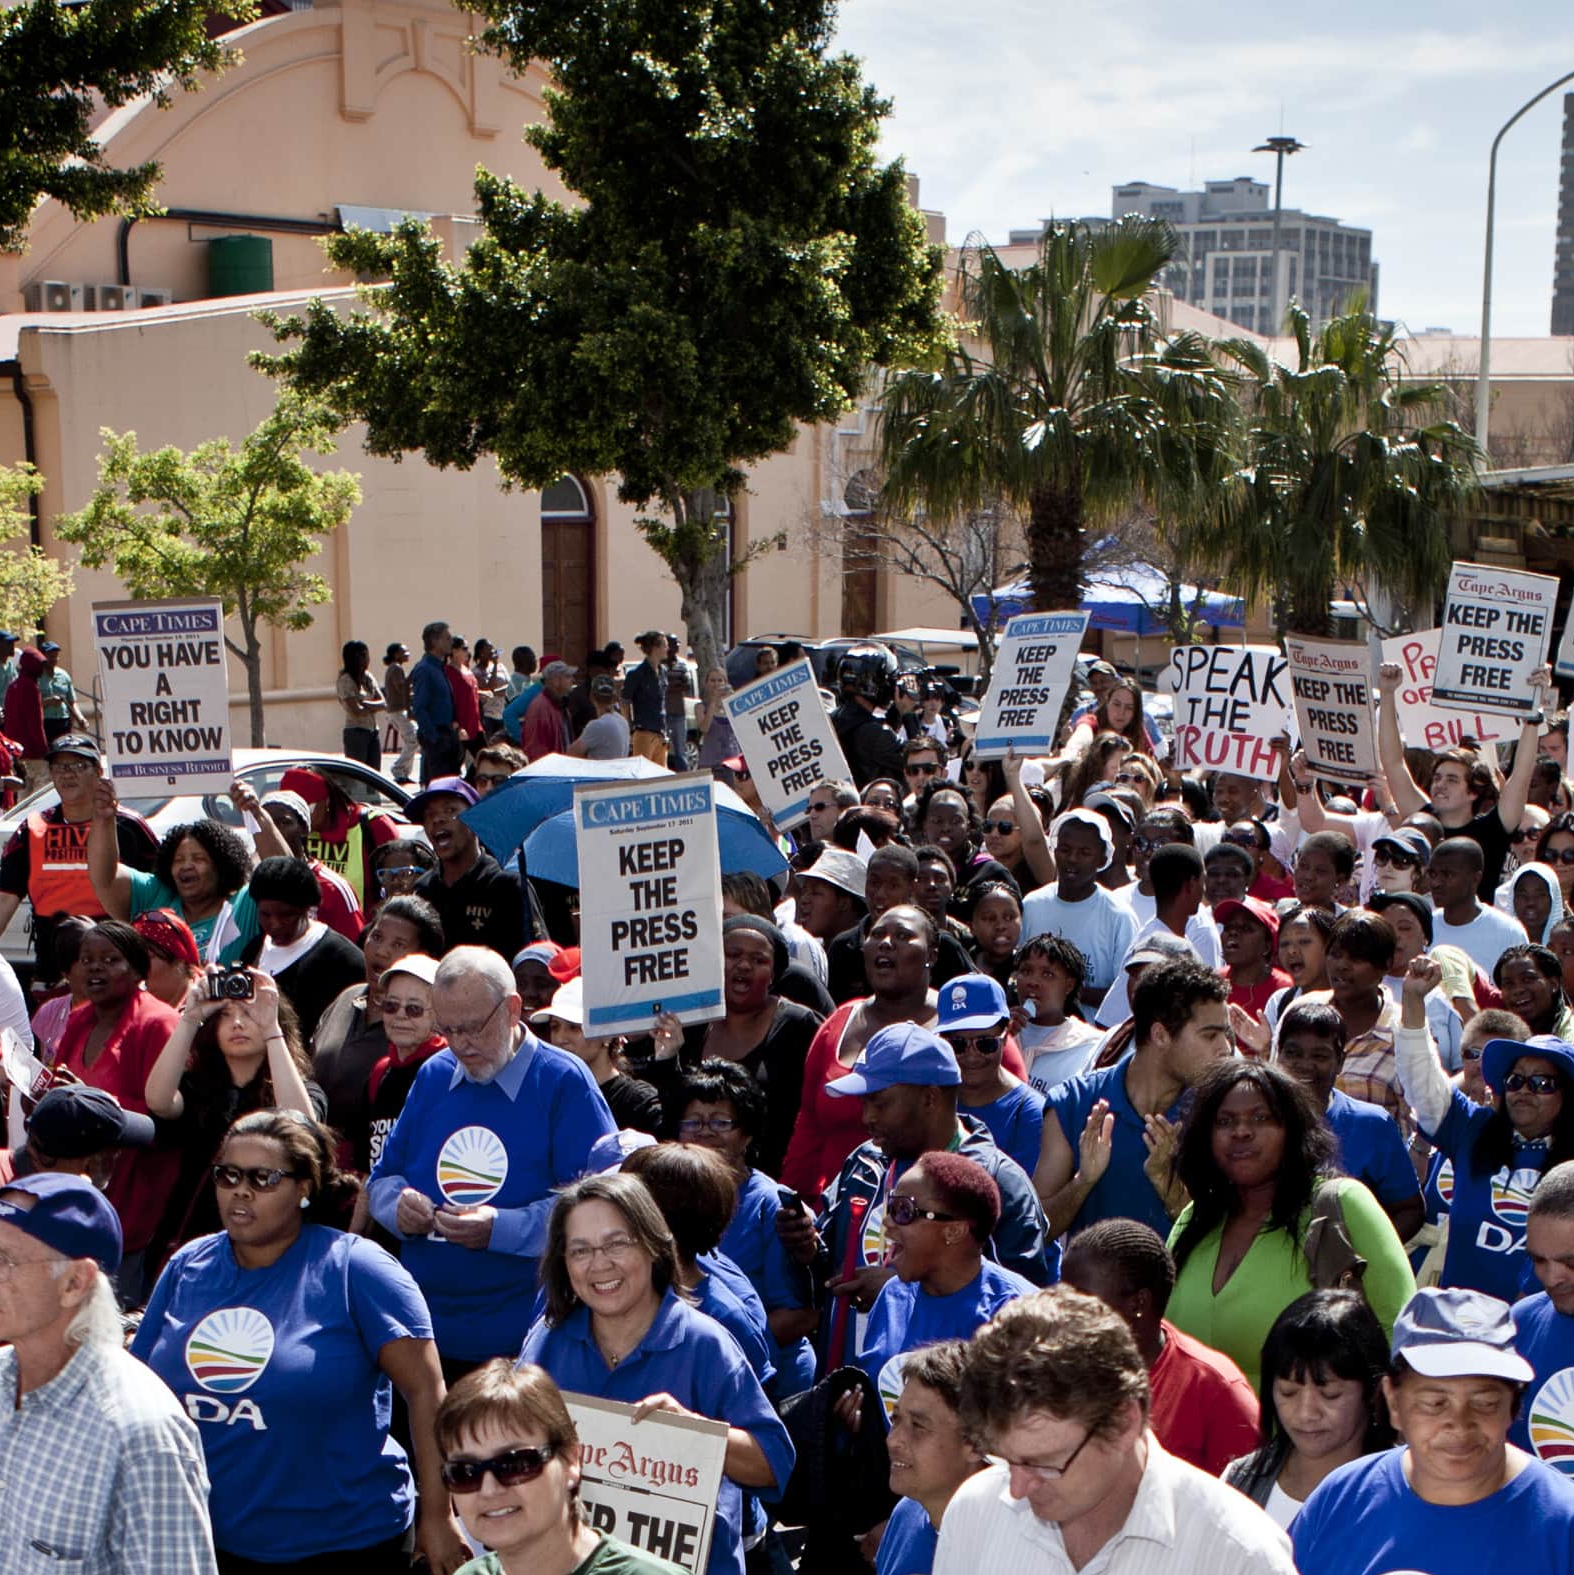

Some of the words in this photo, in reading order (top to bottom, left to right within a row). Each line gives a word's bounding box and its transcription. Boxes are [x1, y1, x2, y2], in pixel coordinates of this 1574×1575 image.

[1458, 578, 1495, 594] Cape
[1496, 582, 1543, 601] Argus
[102, 616, 152, 634] CAPE
[153, 613, 213, 633] TIMES
[1012, 622, 1041, 635] CAPE
[1041, 619, 1081, 633] TIMES
[1447, 603, 1501, 629] KEEP
[1506, 610, 1544, 635] THE
[100, 644, 151, 670] YOU
[157, 641, 221, 667] HAVE
[1015, 645, 1057, 664] KEEP
[1456, 634, 1525, 662] PRESS
[1016, 666, 1045, 685] THE
[1319, 654, 1359, 671] Argus
[1460, 663, 1513, 690] FREE
[155, 673, 172, 696] A
[733, 691, 765, 712] CAPE
[765, 670, 809, 692] TIMES
[1171, 646, 1288, 708] SPEAK
[1293, 675, 1331, 701] KEEP
[1333, 683, 1367, 705] THE
[997, 688, 1050, 707] PRESS
[130, 699, 202, 726] RIGHT
[757, 701, 801, 736] KEEP
[997, 709, 1038, 728] FREE
[1188, 697, 1251, 733] THE
[1307, 708, 1359, 735] PRESS
[112, 730, 144, 754] TO
[148, 726, 223, 753] KNOW
[770, 724, 804, 752] THE
[1425, 716, 1499, 749] BILL
[767, 739, 824, 779] PRESS
[1175, 723, 1275, 775] TRUTH
[1317, 738, 1356, 764] FREE
[134, 763, 184, 776] BUSINESS
[185, 760, 227, 774] REPORT
[781, 762, 824, 796] FREE
[588, 800, 644, 824] CAPE
[646, 791, 706, 817] TIMES
[44, 826, 90, 850] HIV
[619, 838, 685, 876] KEEP
[629, 877, 678, 911] THE
[466, 904, 493, 919] HIV
[611, 910, 698, 951] PRESS
[624, 949, 690, 986] FREE
[185, 1393, 268, 1431] DA
[608, 1441, 700, 1488] Argus
[627, 1511, 699, 1570] THE
